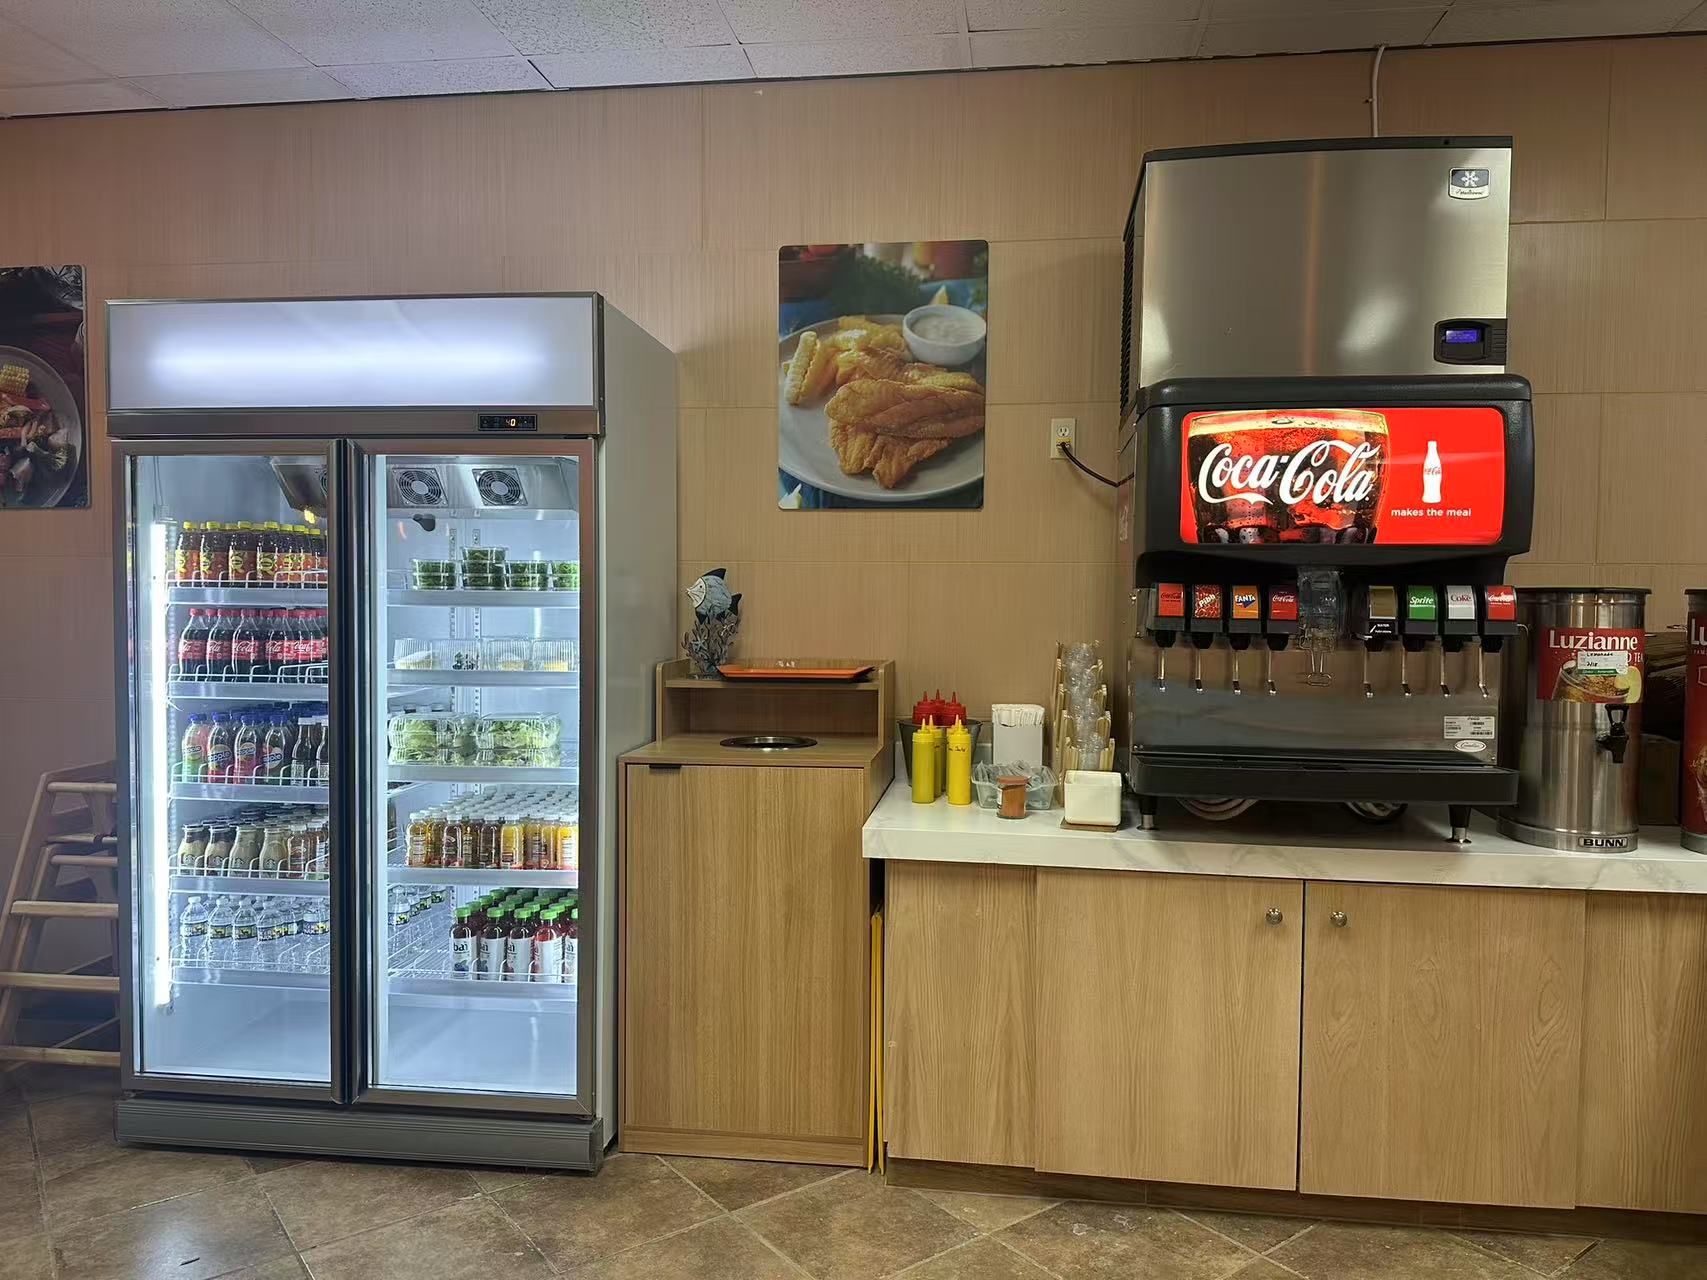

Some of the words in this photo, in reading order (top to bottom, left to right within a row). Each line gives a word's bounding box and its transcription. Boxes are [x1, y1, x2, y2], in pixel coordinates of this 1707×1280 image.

[1198, 439, 1381, 505] Coca-Cola
[1391, 508, 1424, 517] makes
[1426, 508, 1443, 517] the
[1446, 508, 1472, 517] meal
[1199, 594, 1216, 608] Pibb
[1409, 596, 1434, 604] Sprite
[1549, 630, 1638, 651] Luzianne
[1583, 838, 1624, 847] BUNN
